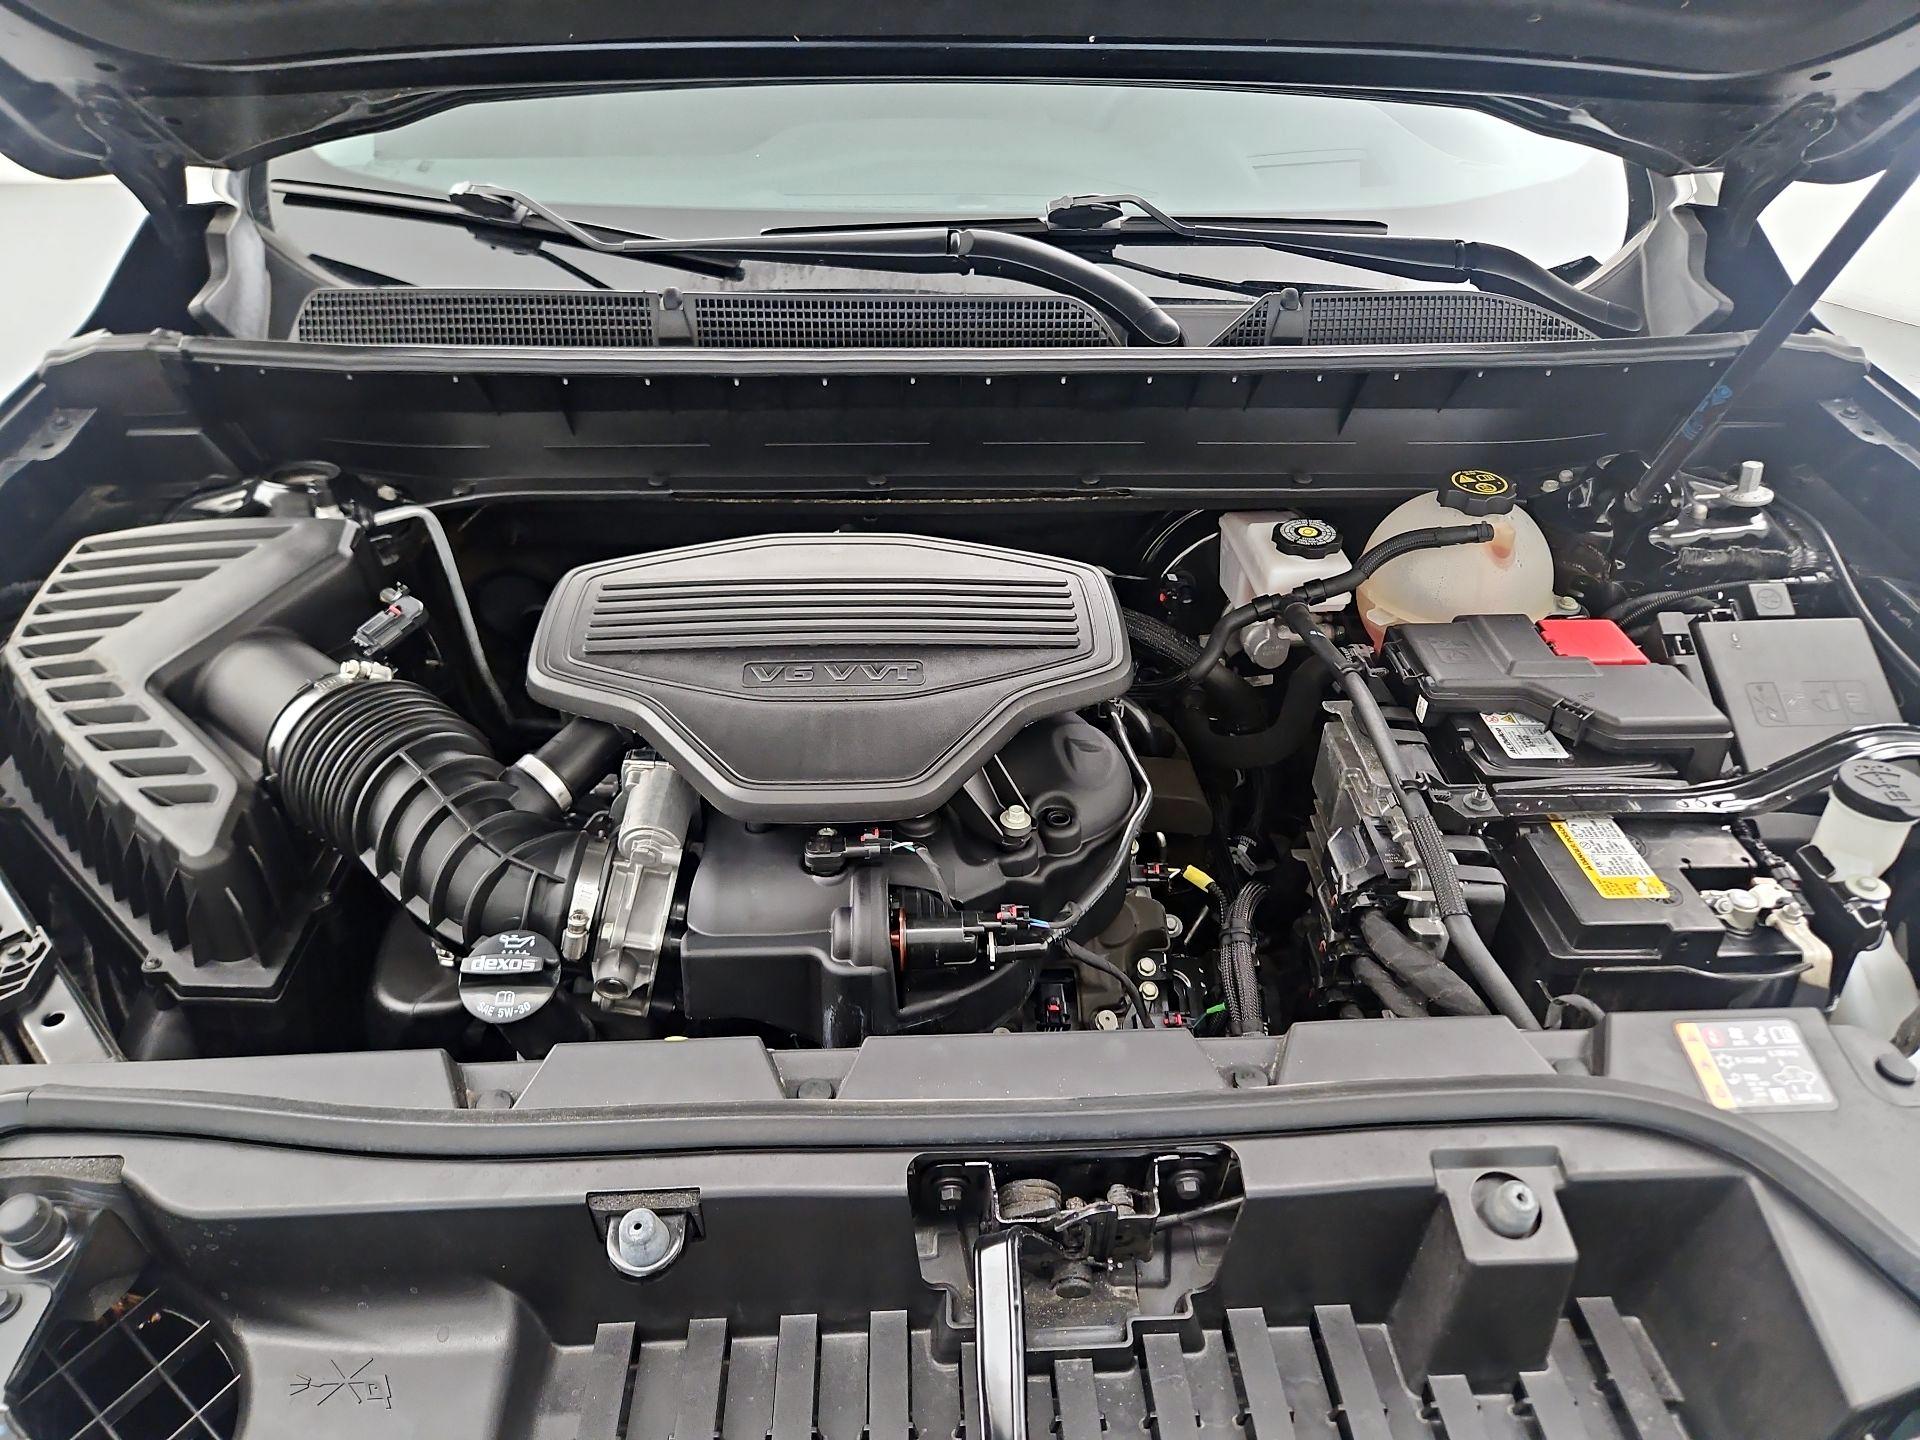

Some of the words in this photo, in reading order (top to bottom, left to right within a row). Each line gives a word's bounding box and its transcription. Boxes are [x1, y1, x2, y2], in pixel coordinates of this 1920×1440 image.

[750, 665, 814, 682] V6
[824, 664, 918, 681] VVT
[470, 955, 537, 971] dexos
[477, 1002, 495, 1016] SAE
[497, 1001, 531, 1018] 5W-30
